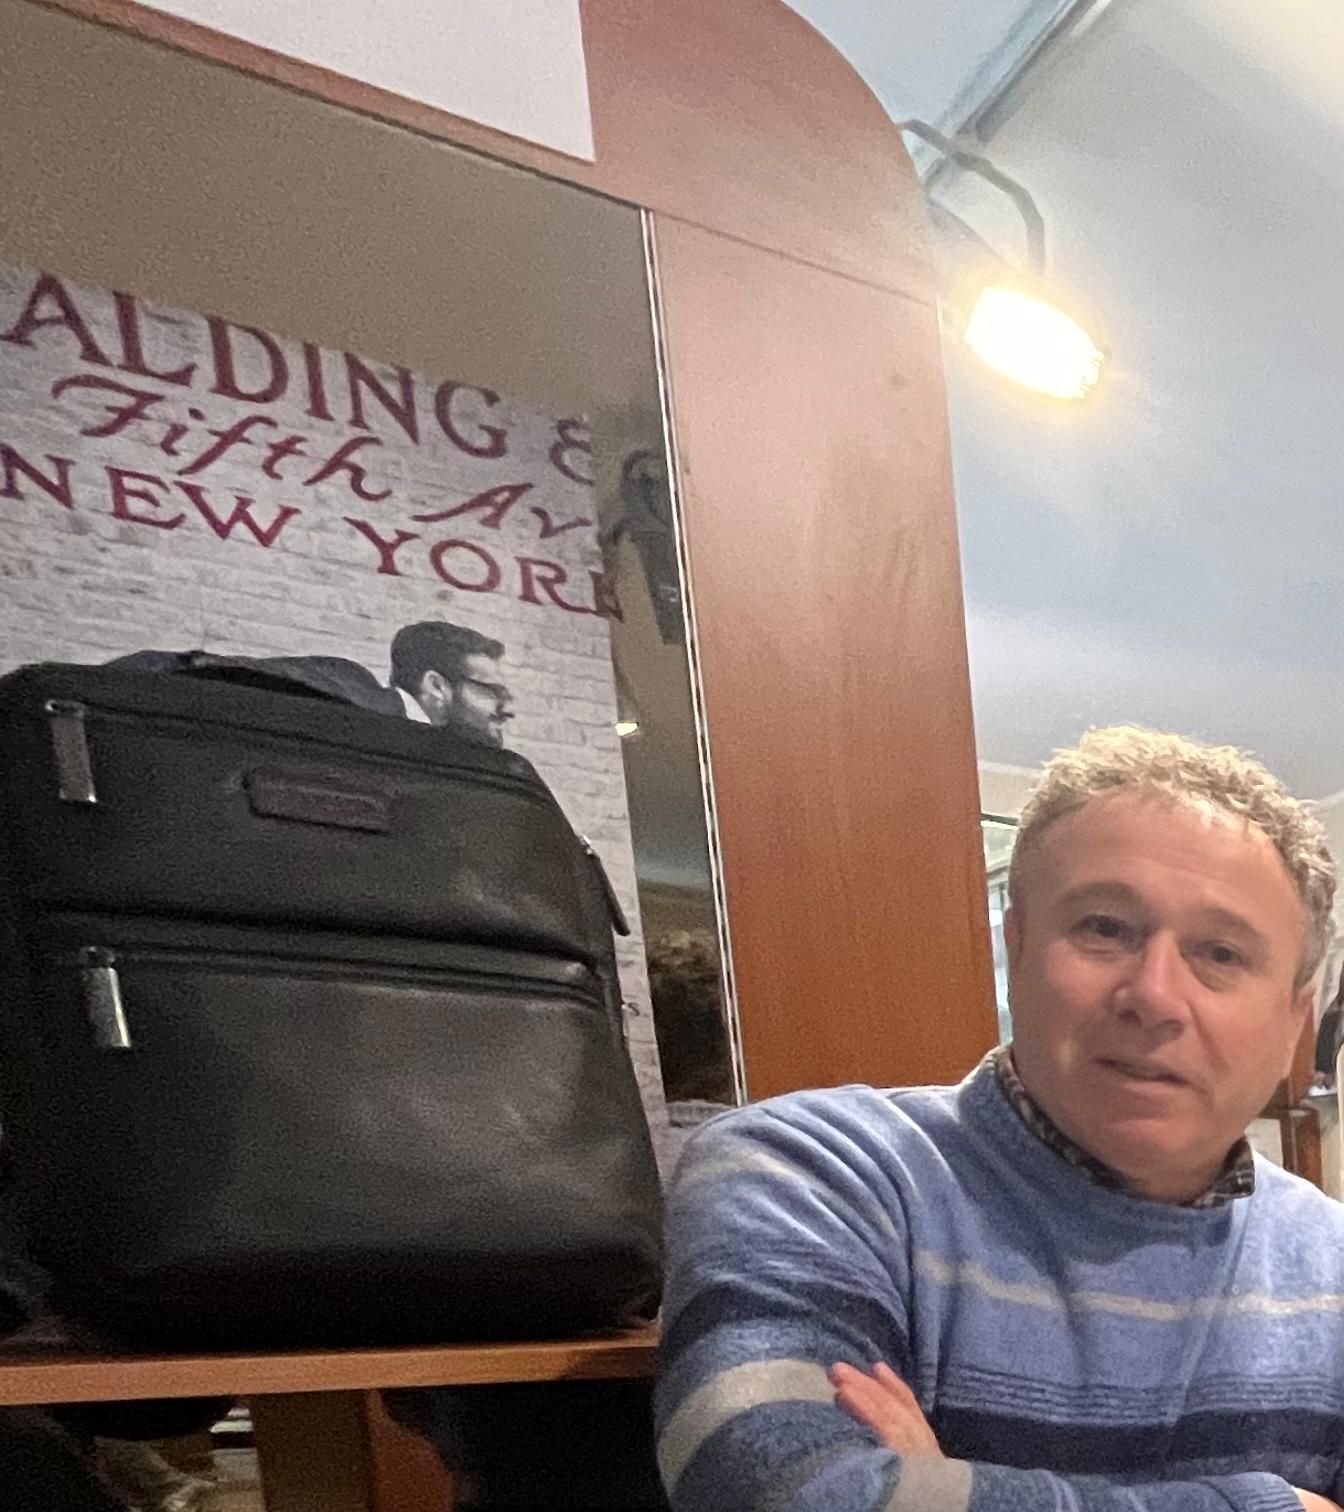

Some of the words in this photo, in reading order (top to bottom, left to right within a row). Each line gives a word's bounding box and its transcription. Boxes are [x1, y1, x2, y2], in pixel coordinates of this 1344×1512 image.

[0, 272, 508, 459] ALDING
[0, 443, 301, 548] NEW
[52, 373, 393, 501] Fifth
